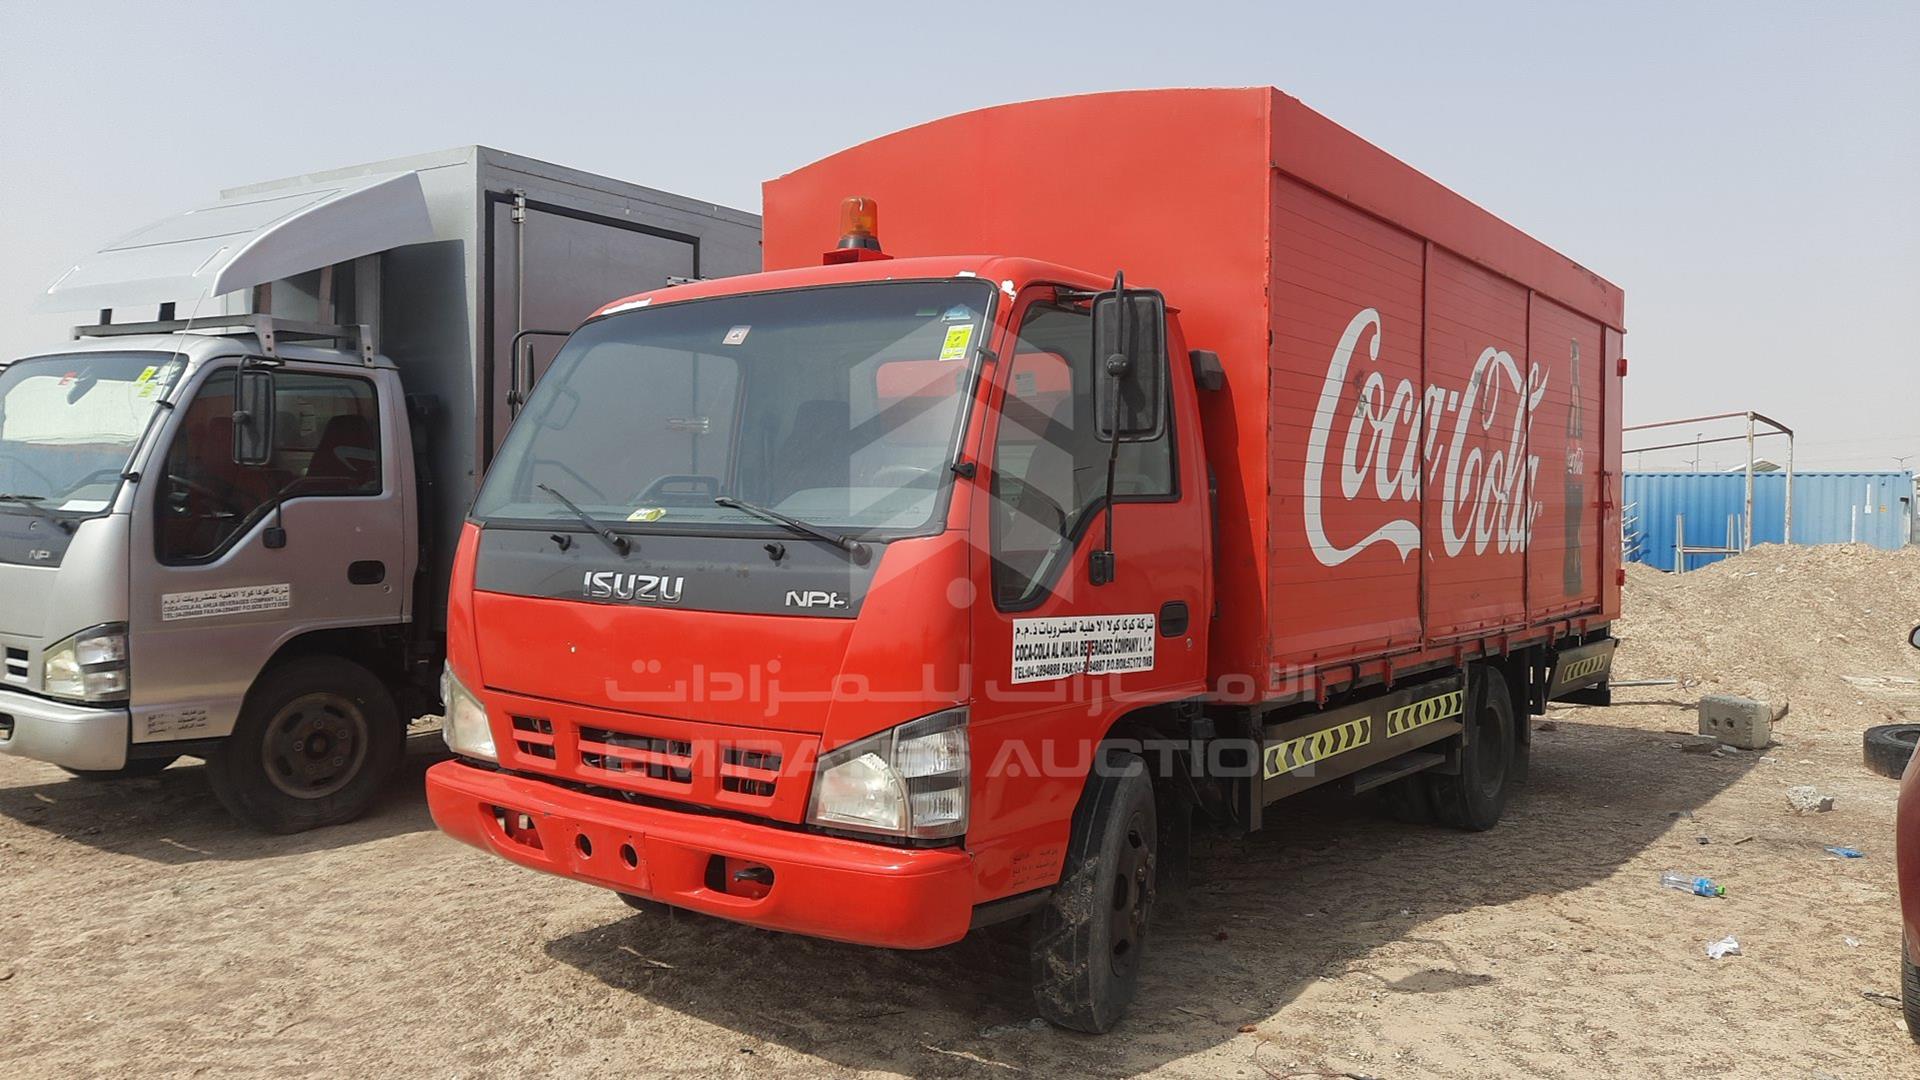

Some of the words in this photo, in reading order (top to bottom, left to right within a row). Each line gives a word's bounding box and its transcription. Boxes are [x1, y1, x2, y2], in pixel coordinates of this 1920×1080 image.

[1304, 308, 1550, 566] Coca-Cola
[584, 571, 684, 604] ISUZU
[1137, 617, 1154, 633] شركة
[1014, 642, 1050, 662] COCA-COLA
[1051, 642, 1060, 659] AL
[1061, 641, 1079, 658] AHLIA
